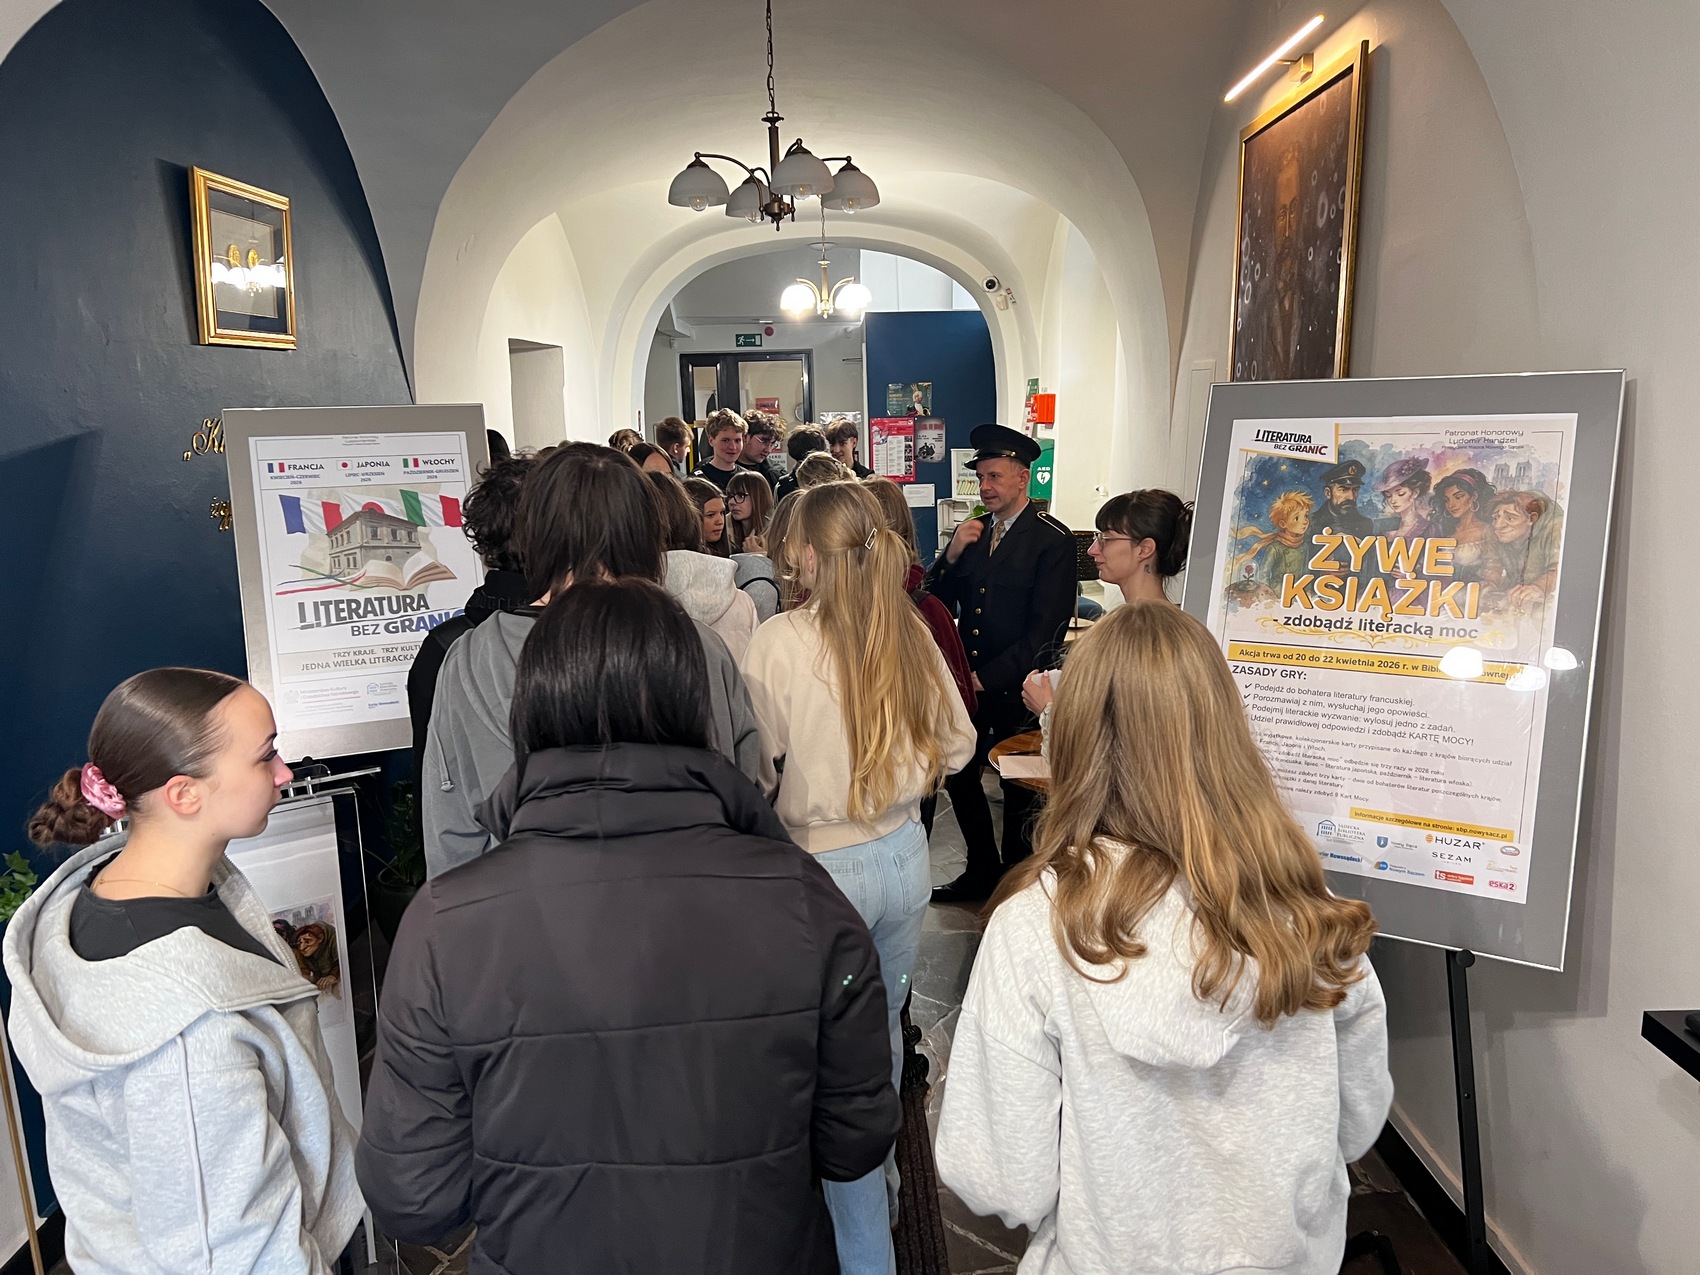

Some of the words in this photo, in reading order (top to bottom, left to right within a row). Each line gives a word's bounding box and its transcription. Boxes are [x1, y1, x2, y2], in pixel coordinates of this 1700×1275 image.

[1254, 429, 1312, 443] LITERATURA
[1288, 445, 1328, 455] GRANIC
[288, 463, 325, 471] FRANCJA
[422, 458, 456, 466] WŁOCHY
[1308, 526, 1457, 576] ŻYWE
[1280, 572, 1480, 622] KSIĄŻKI
[297, 594, 430, 630] LITERATURA
[351, 623, 381, 637] BEZ
[1283, 614, 1353, 632] zdobądź
[1358, 618, 1434, 638] literacką
[1436, 626, 1478, 639] moc
[301, 662, 331, 671] JEDNA
[332, 658, 367, 668] WIELKA
[369, 654, 415, 664] LITERACKA
[1239, 649, 1260, 658] Akcja
[1322, 656, 1334, 664] 22
[1336, 656, 1375, 667] kwietnia
[1377, 660, 1400, 669] 2026
[1232, 665, 1278, 677] ZASADY
[1280, 670, 1307, 680] GRY:
[1254, 684, 1284, 694] Podejdź
[1298, 688, 1331, 697] bohatera
[1334, 691, 1368, 702] literatury
[1370, 694, 1415, 707] francuskiej.
[1253, 694, 1300, 706] Porozmawiaj
[1309, 700, 1325, 708] nim,
[1328, 702, 1365, 713] wysłuchaj
[1367, 705, 1385, 715] jego
[1387, 708, 1430, 718] opowieści.
[1252, 704, 1284, 715] Podejmij
[1286, 707, 1319, 717] literackie
[1321, 712, 1361, 722] wyzwanie:
[1364, 717, 1393, 727] wylosuj
[1394, 719, 1418, 728] jedno
[1427, 724, 1456, 733] zadań.
[1250, 714, 1274, 723] Udziel
[1275, 717, 1320, 730] prawidłowej
[1322, 723, 1365, 734] odpowiedzi
[1372, 728, 1406, 739] zdobądź
[1408, 732, 1440, 744] KARTĘ
[1442, 736, 1474, 746] MOCY!
[1402, 748, 1427, 756] każdego
[1435, 752, 1456, 760] krajów
[1325, 763, 1351, 771] literatura
[1419, 775, 1446, 784] literatura
[1407, 784, 1430, 792] literatur
[1354, 811, 1385, 820] Informacje
[1432, 822, 1454, 831] stronie:
[1456, 827, 1508, 839] sbp.nowysacz.pl
[1435, 836, 1482, 850] HUZAR
[1432, 852, 1472, 863] SEZAM
